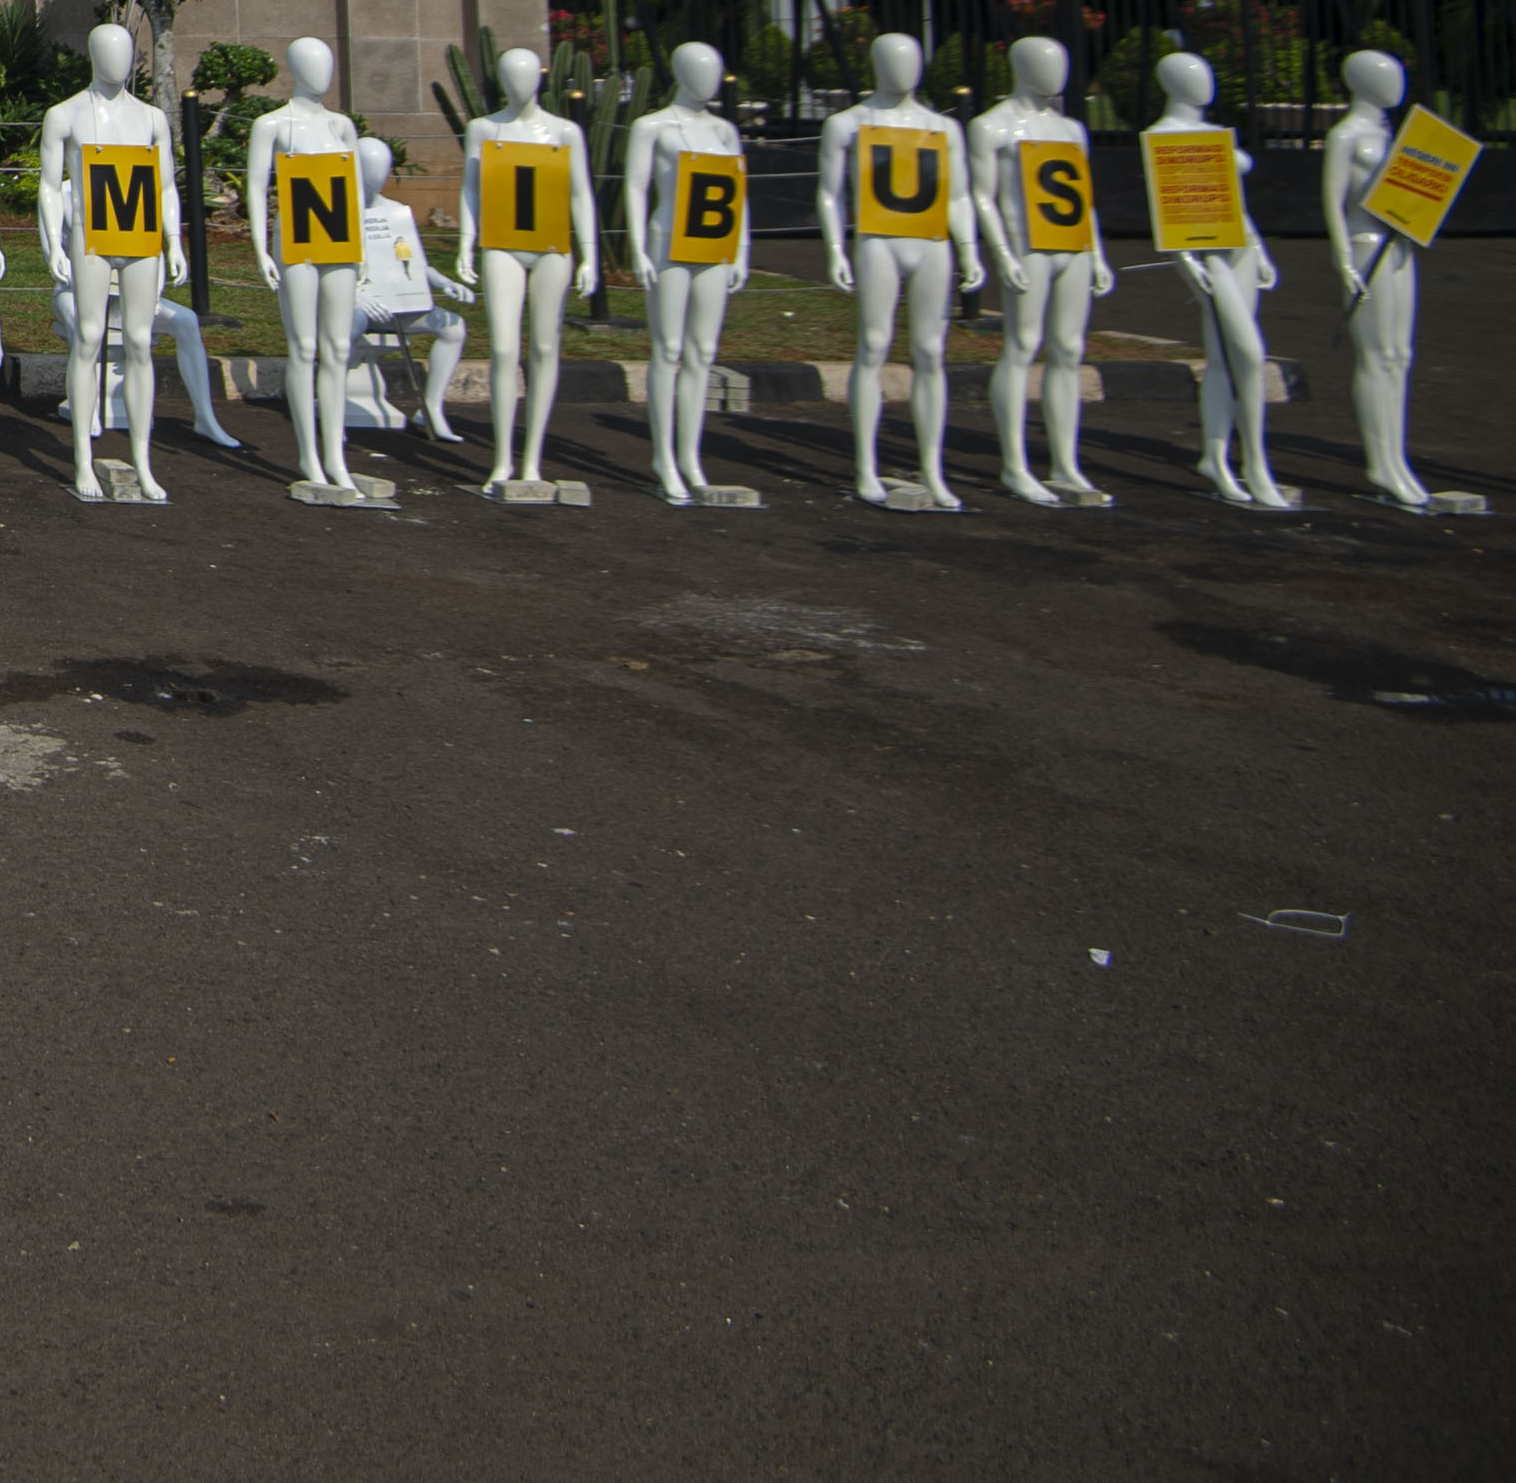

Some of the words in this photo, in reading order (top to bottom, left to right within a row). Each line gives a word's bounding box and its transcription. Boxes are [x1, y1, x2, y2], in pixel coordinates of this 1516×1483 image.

[89, 163, 157, 232] M
[290, 176, 349, 244] N
[514, 165, 536, 232] I
[684, 171, 737, 240] B
[871, 144, 939, 214] U
[1037, 159, 1084, 227] S
